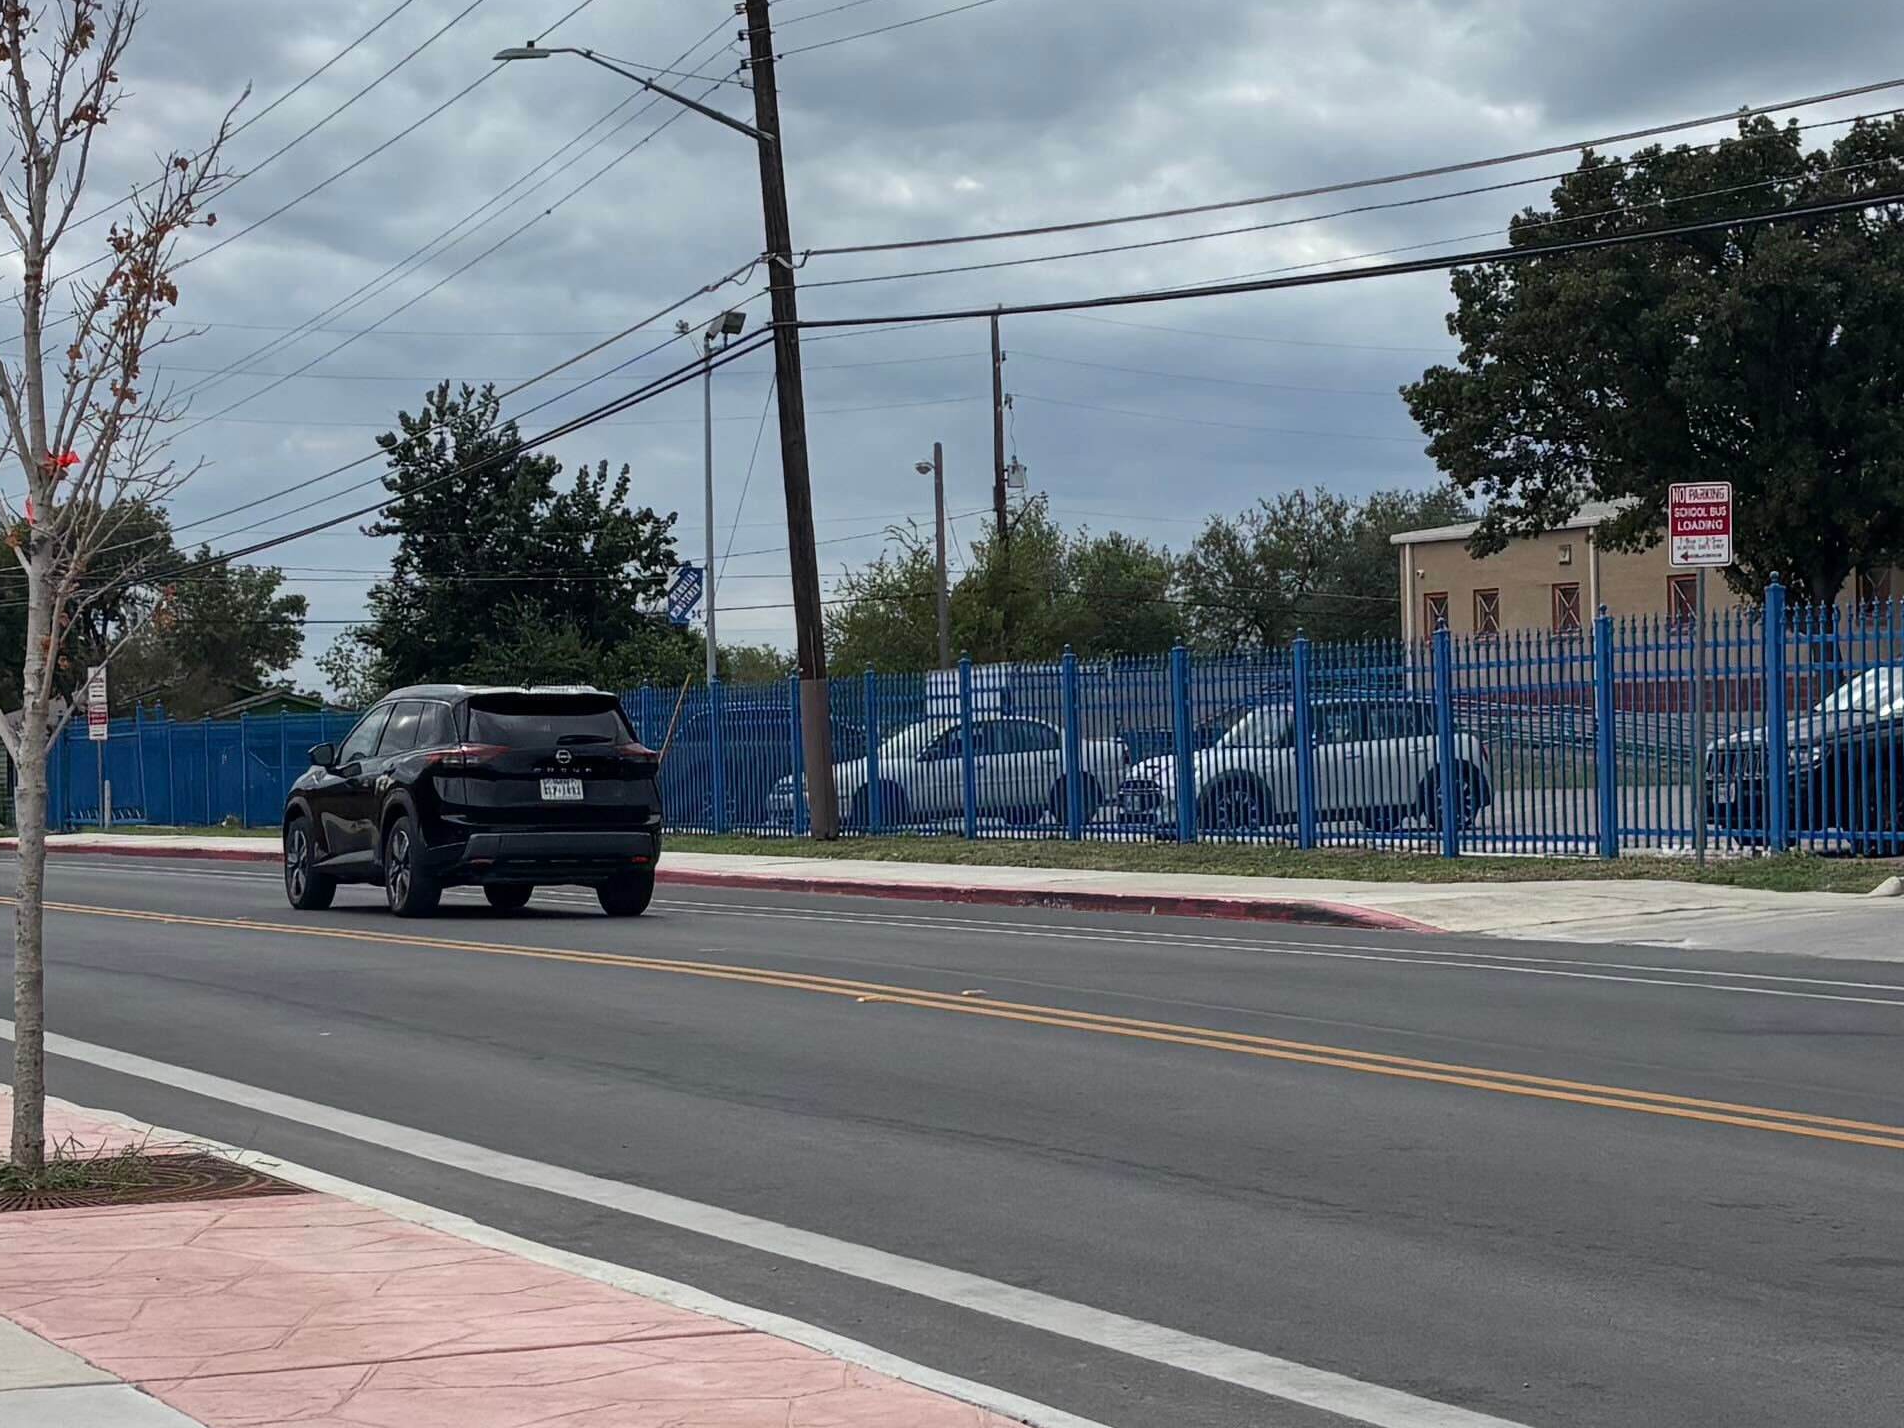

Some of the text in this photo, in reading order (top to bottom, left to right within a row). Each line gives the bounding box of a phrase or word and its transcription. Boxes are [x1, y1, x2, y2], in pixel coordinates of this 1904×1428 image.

[1672, 487, 1725, 504] NO PARKING
[1674, 506, 1727, 518] SCHOOL BUS
[1677, 519, 1724, 532] LOADING
